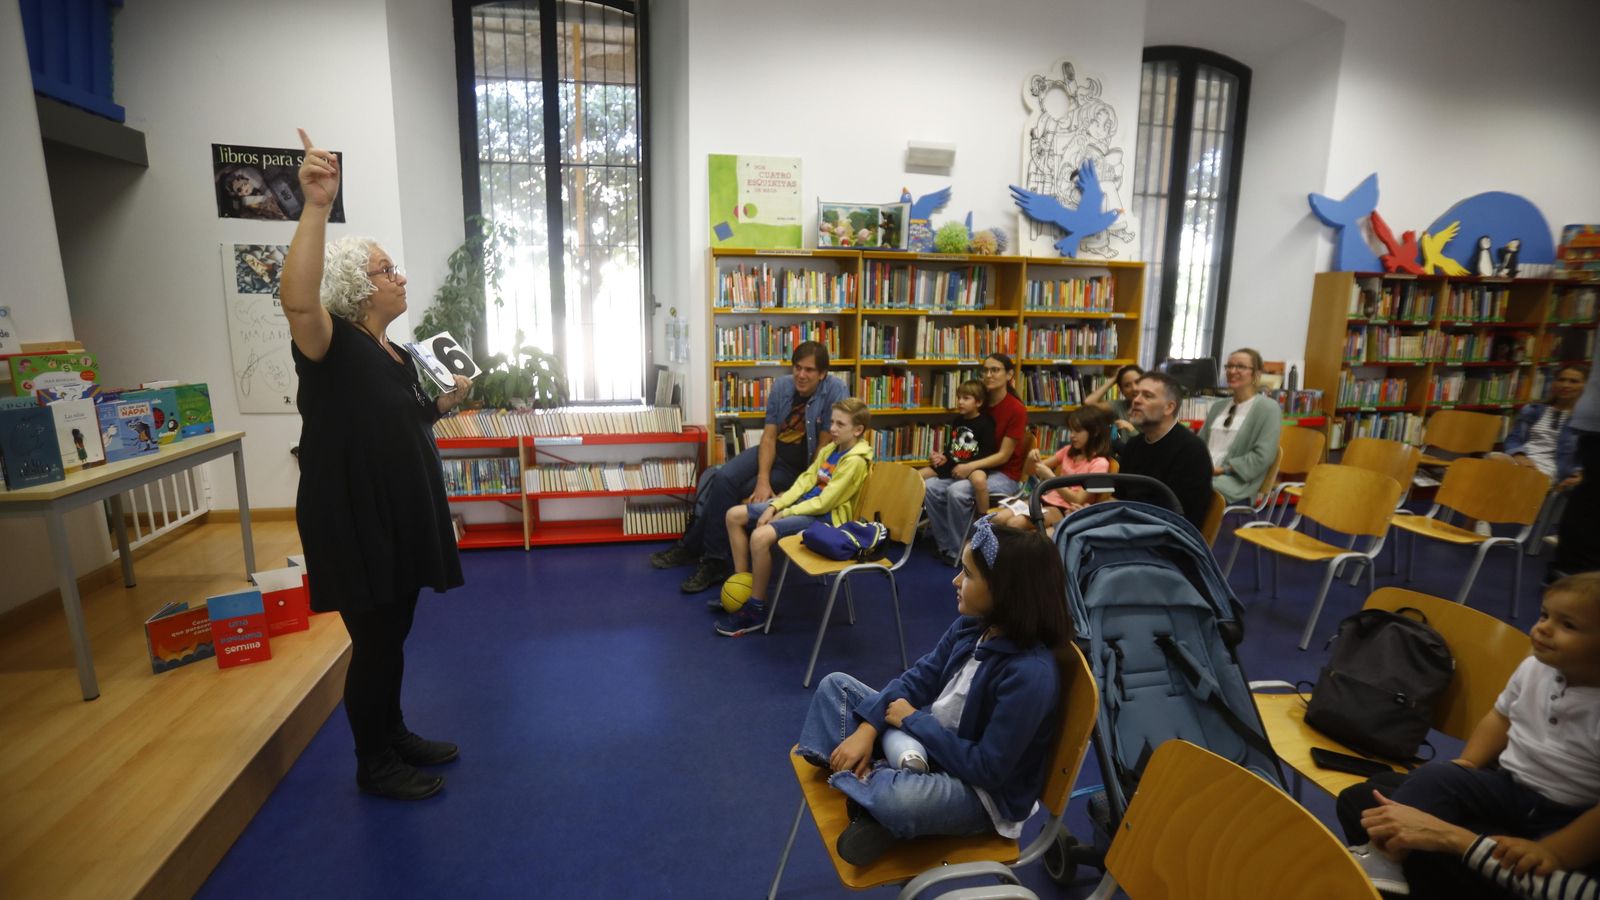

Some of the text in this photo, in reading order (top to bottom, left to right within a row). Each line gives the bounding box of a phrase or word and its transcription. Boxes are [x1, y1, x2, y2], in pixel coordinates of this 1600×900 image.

[220, 146, 259, 165] libros
[262, 153, 294, 170] para
[759, 171, 792, 180] CUATRO
[747, 179, 798, 188] ESQUINITAS
[432, 337, 476, 378] 6
[224, 641, 262, 655] semilla
